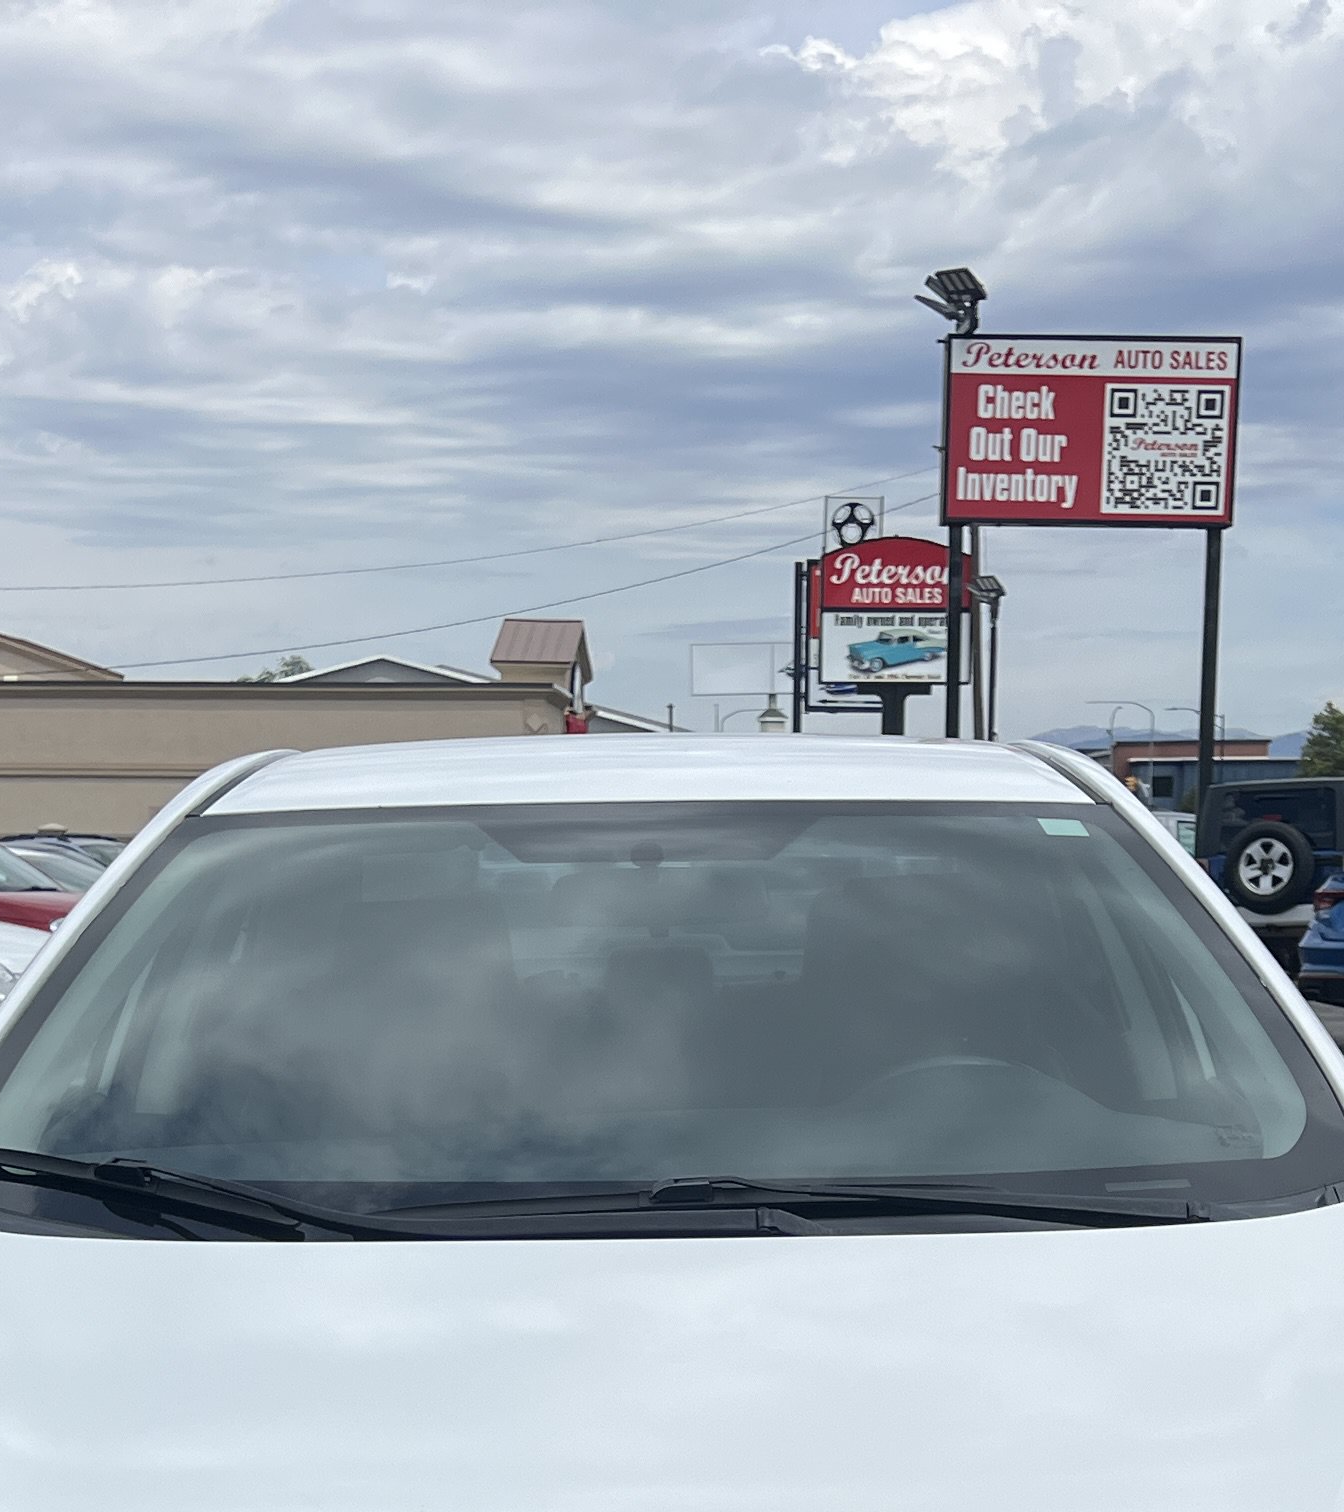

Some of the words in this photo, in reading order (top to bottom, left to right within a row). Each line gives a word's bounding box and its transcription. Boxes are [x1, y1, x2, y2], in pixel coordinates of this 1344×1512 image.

[961, 341, 1099, 370] Peterson
[1114, 349, 1163, 370] AUTO
[1170, 350, 1228, 371] SALES
[977, 384, 1055, 420] Check
[969, 427, 1013, 462] Out
[1019, 428, 1068, 462] Our
[956, 467, 1078, 509] Inventory
[851, 588, 892, 604] AUTO
[895, 588, 943, 604] SALES
[834, 614, 863, 628] Family
